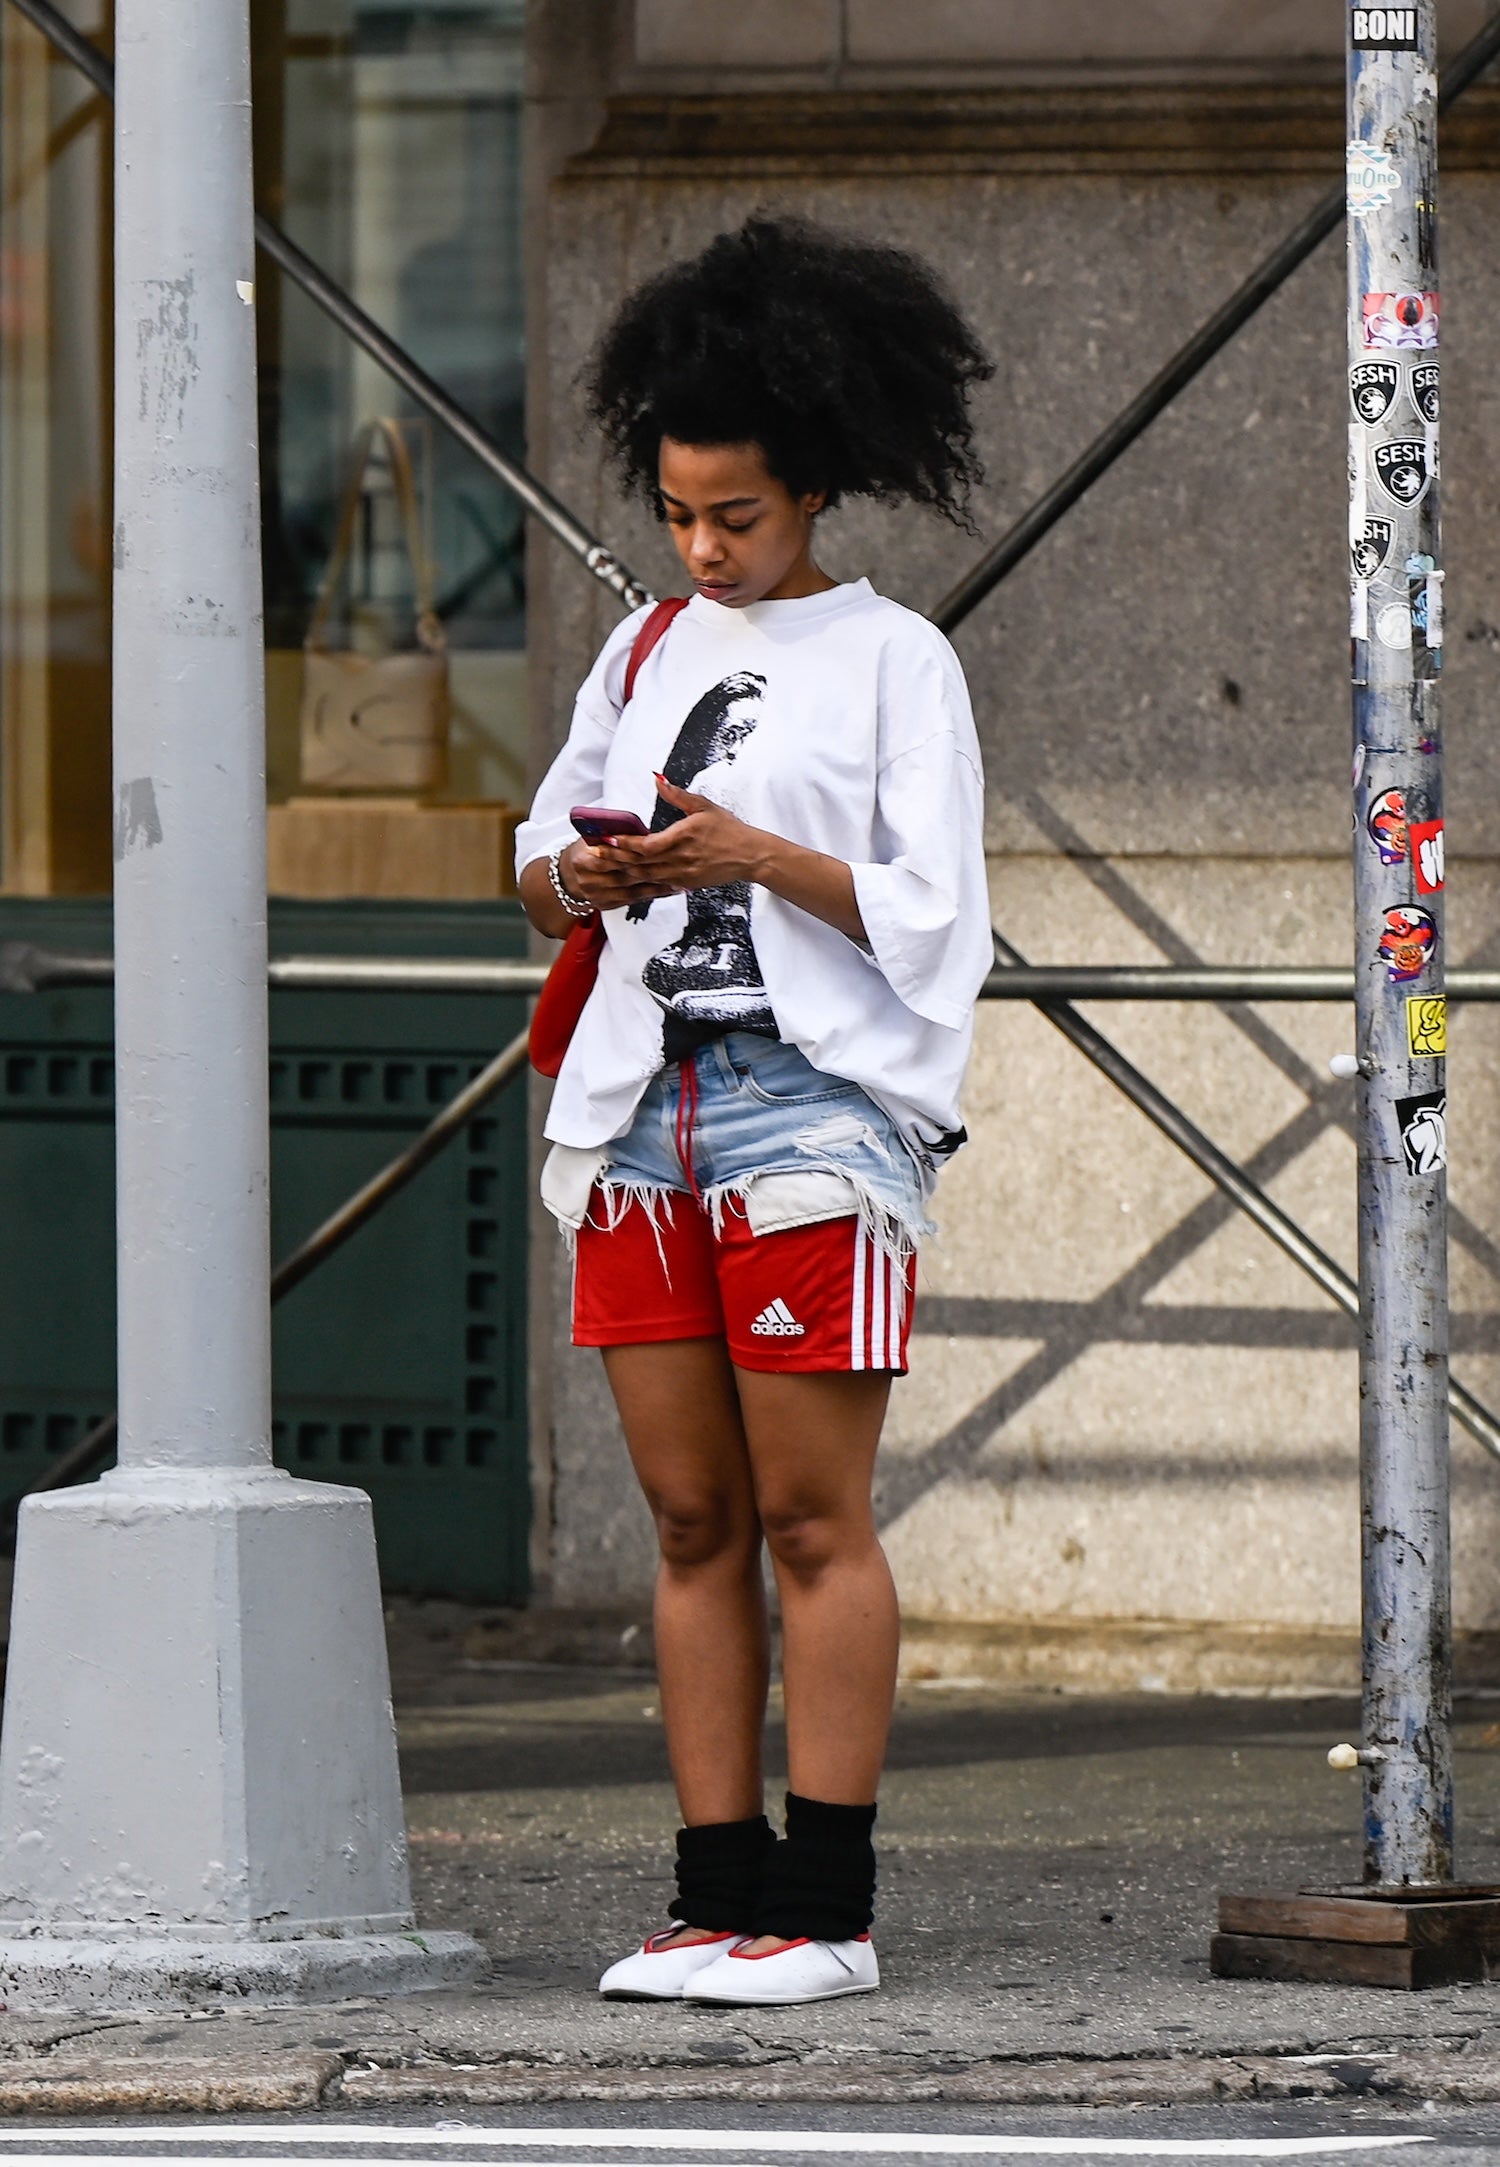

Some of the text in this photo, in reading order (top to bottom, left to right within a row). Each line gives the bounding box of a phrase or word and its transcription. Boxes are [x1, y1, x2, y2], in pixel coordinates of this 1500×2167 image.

[1353, 9, 1415, 41] BONI
[1351, 365, 1396, 390] SESH
[1362, 522, 1389, 542] SH
[750, 1321, 805, 1336] adidas
